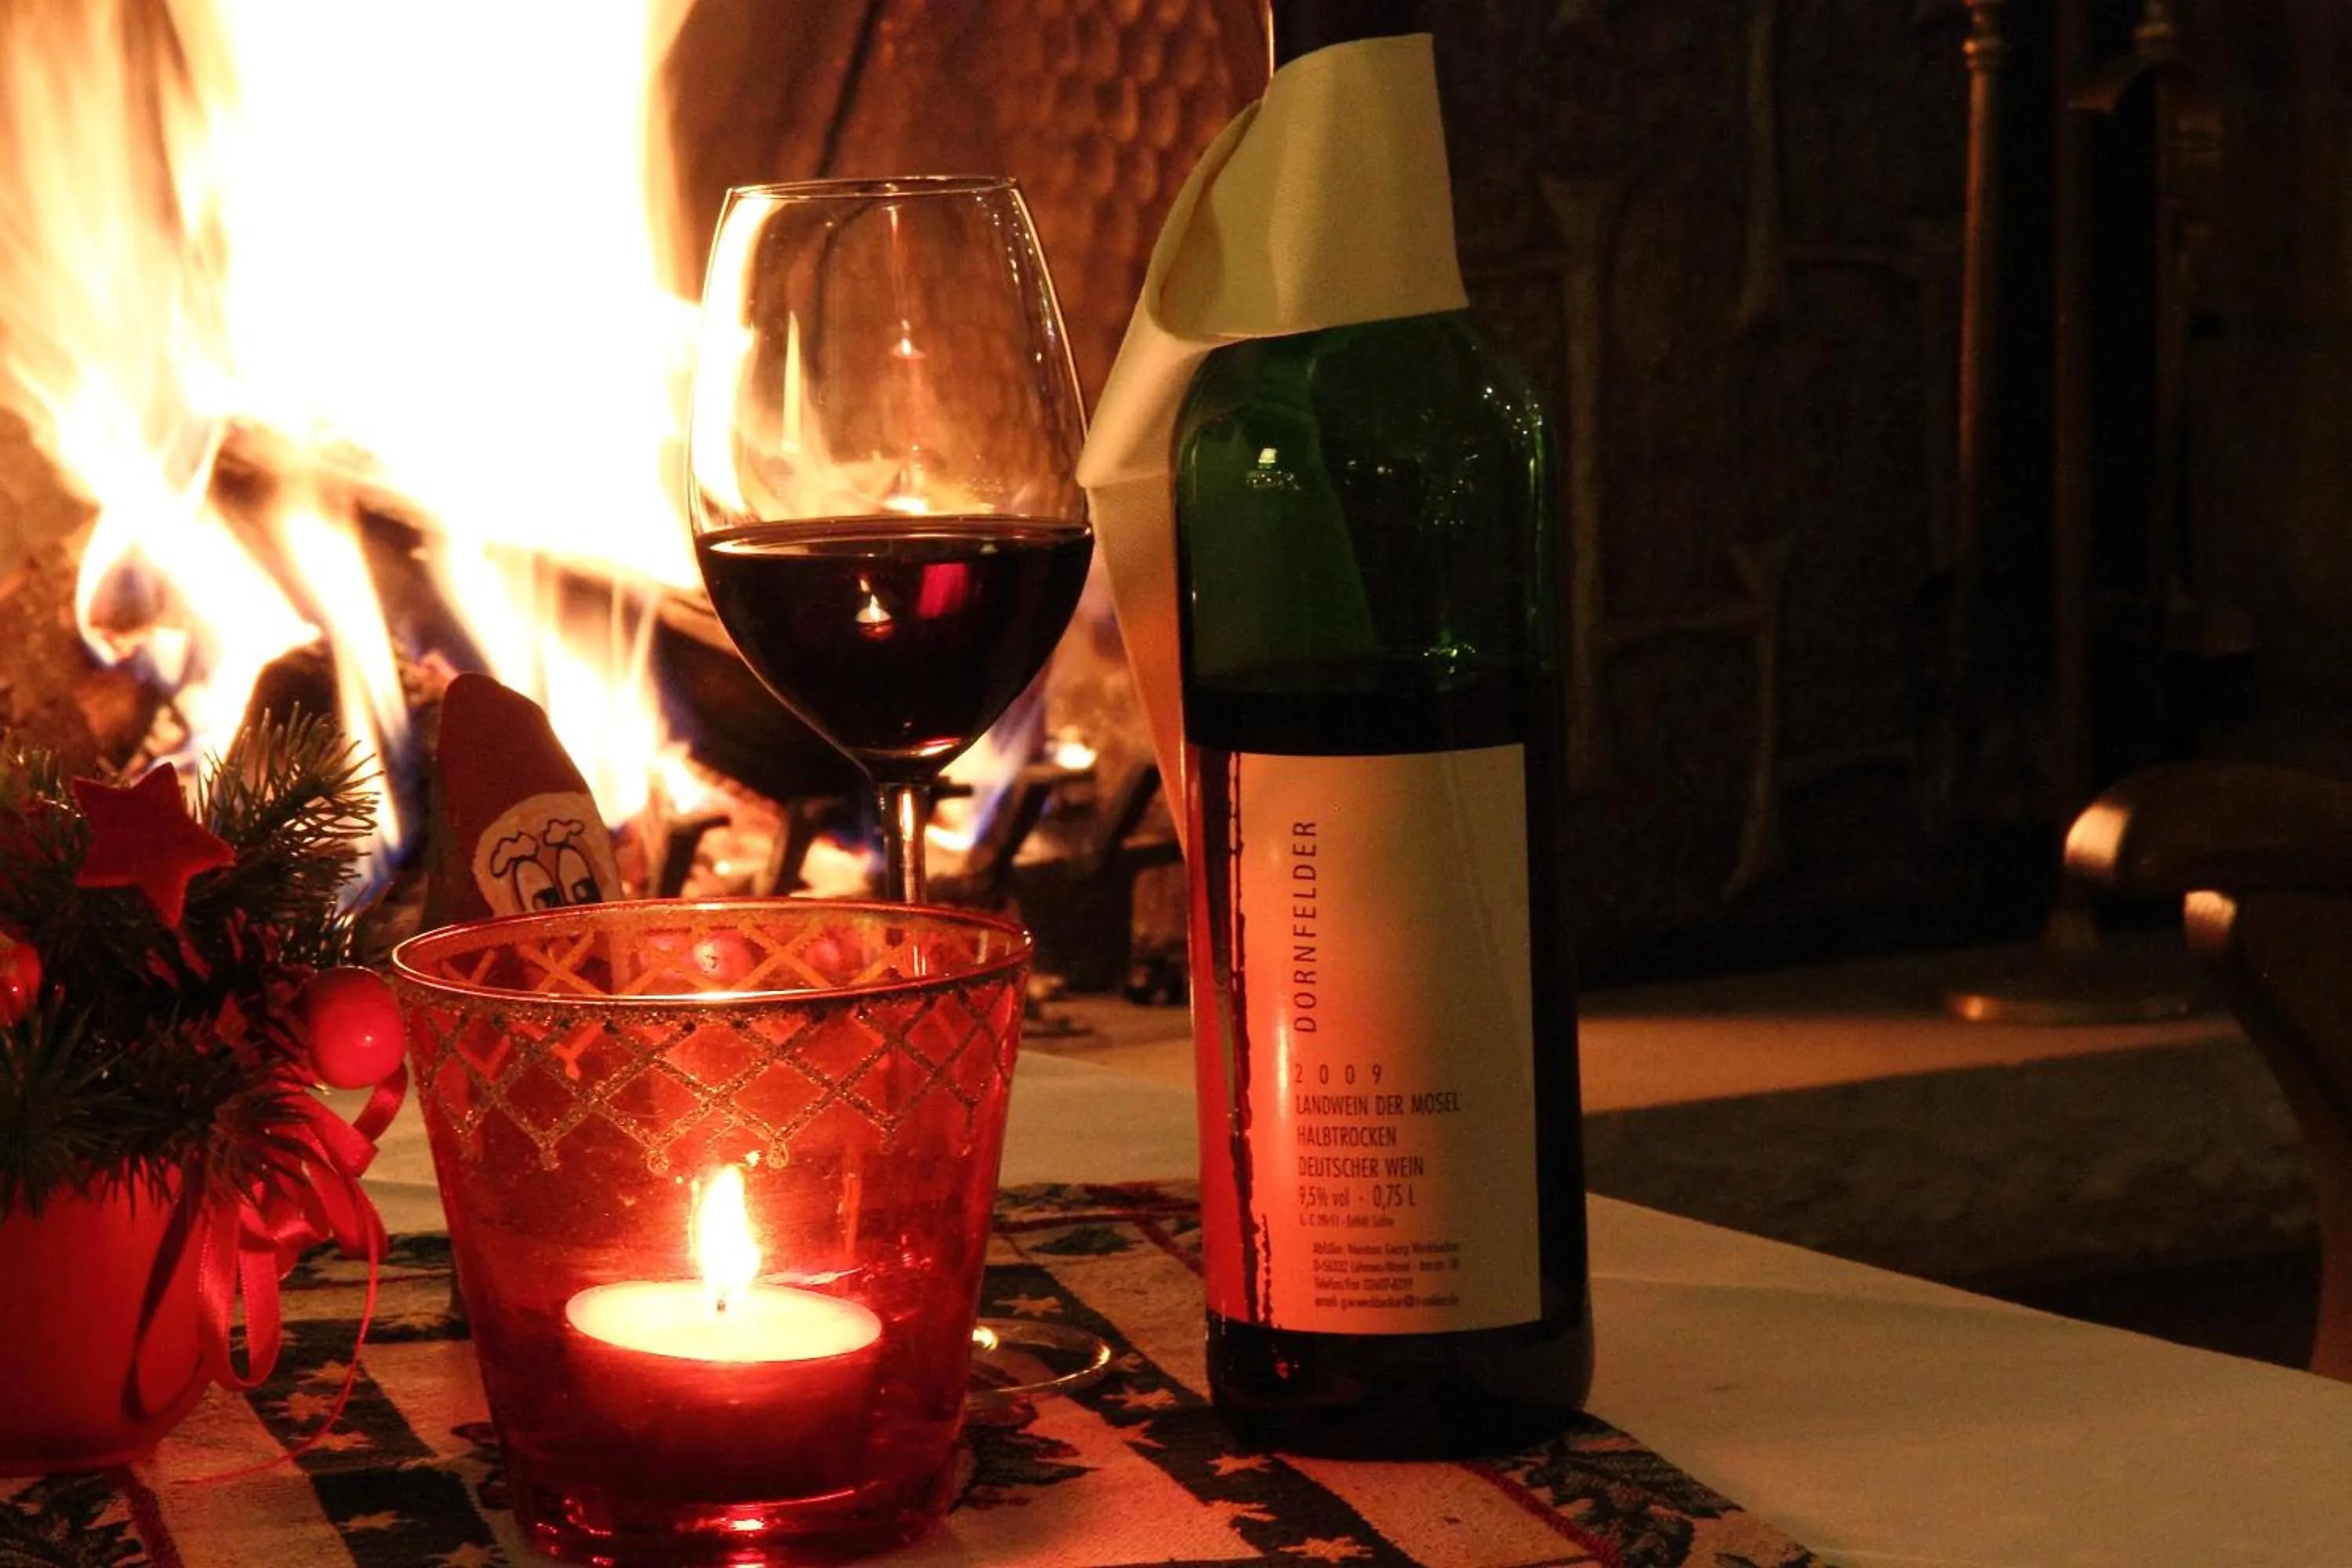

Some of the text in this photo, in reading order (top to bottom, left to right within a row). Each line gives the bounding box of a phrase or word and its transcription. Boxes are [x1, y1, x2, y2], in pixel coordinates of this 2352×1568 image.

[1293, 820, 1317, 1034] DORNFELDER
[1295, 1091, 1461, 1116] LANDWEIN DER MOSEL
[1297, 1126, 1397, 1146] HALBTROCKEN
[1298, 1156, 1424, 1178] DEUTSCHER WEIN
[1372, 1183, 1403, 1209] 0,75
[1408, 1184, 1417, 1207] L
